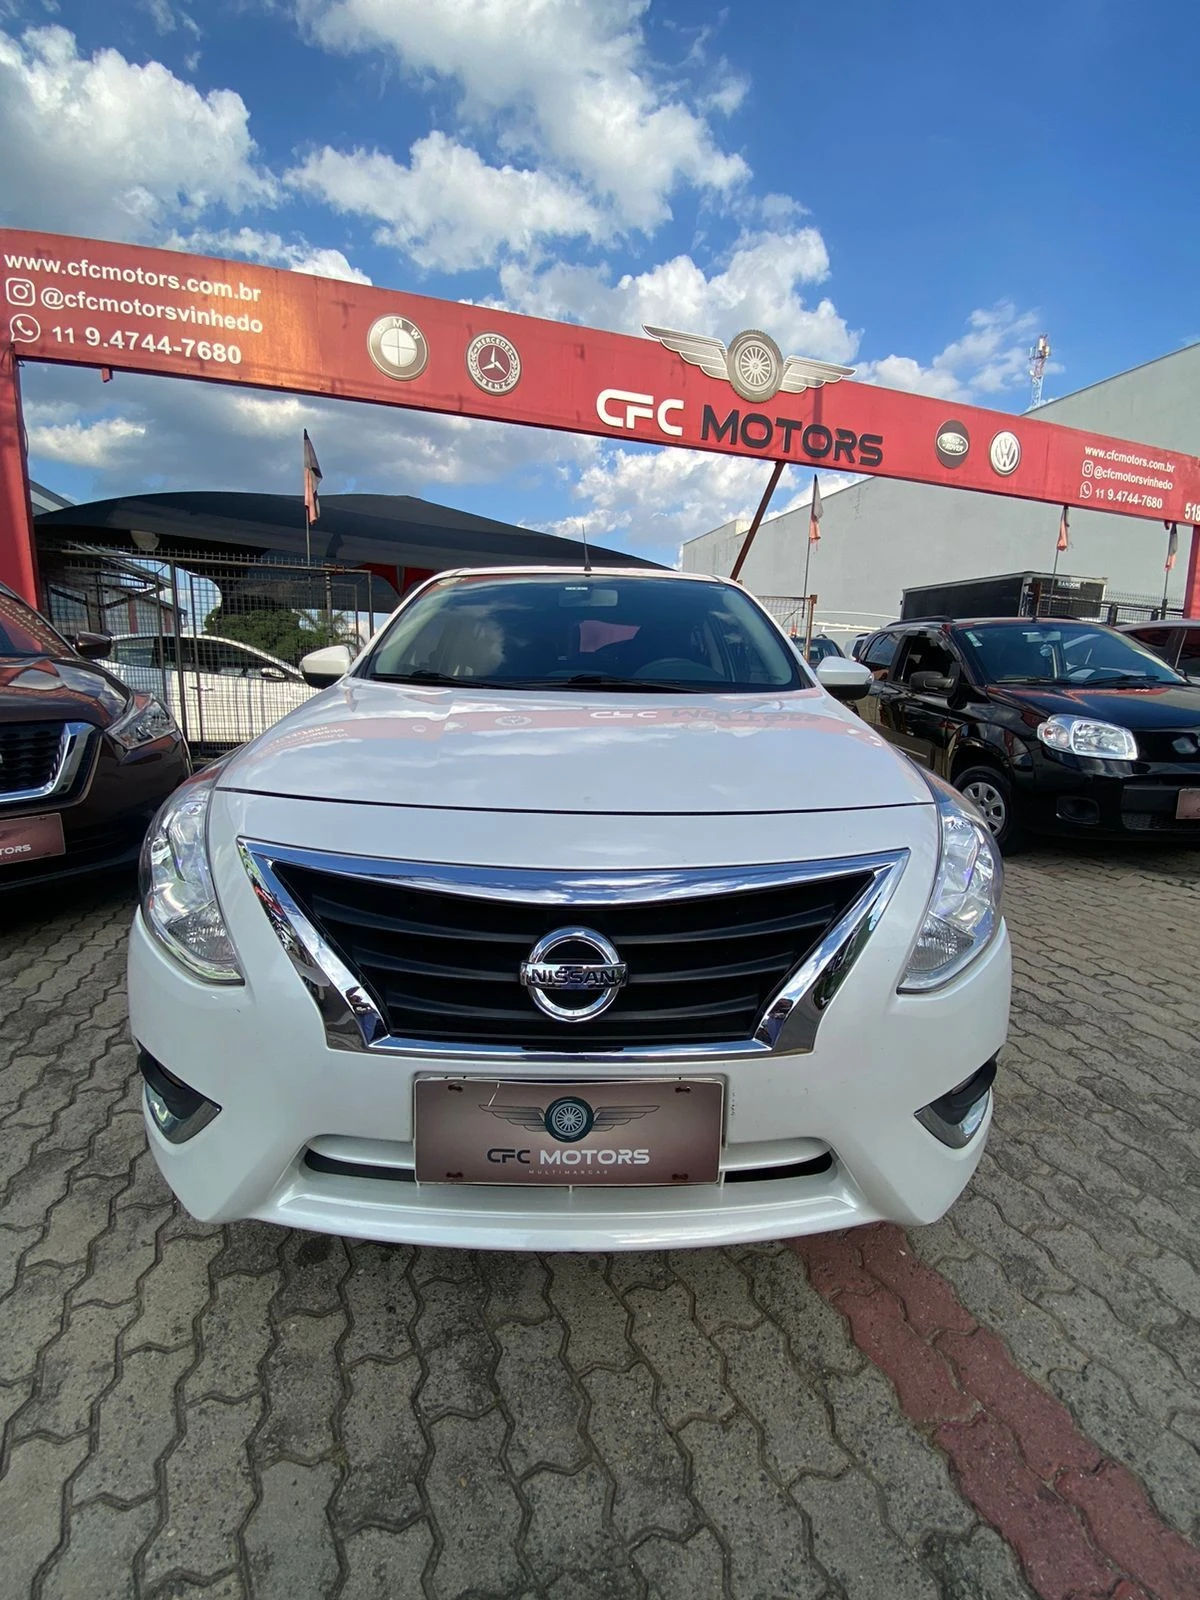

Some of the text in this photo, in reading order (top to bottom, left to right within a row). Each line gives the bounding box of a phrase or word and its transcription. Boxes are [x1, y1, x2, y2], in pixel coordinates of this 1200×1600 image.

[4, 254, 262, 302] www.cfcmotors.com.br
[40, 287, 263, 333] @cfcmotorsvinhedo
[52, 327, 242, 365] 11 9.4744-7680
[596, 388, 884, 467] CFC MOTORS
[1084, 445, 1175, 473] www.cfcmotors.com.br
[1094, 465, 1173, 491] @cfcmotorsvinhedo
[1095, 487, 1163, 509] 11 9.4744-7680
[531, 968, 616, 984] NISSAN
[487, 1148, 650, 1165] CFC MOTORS
